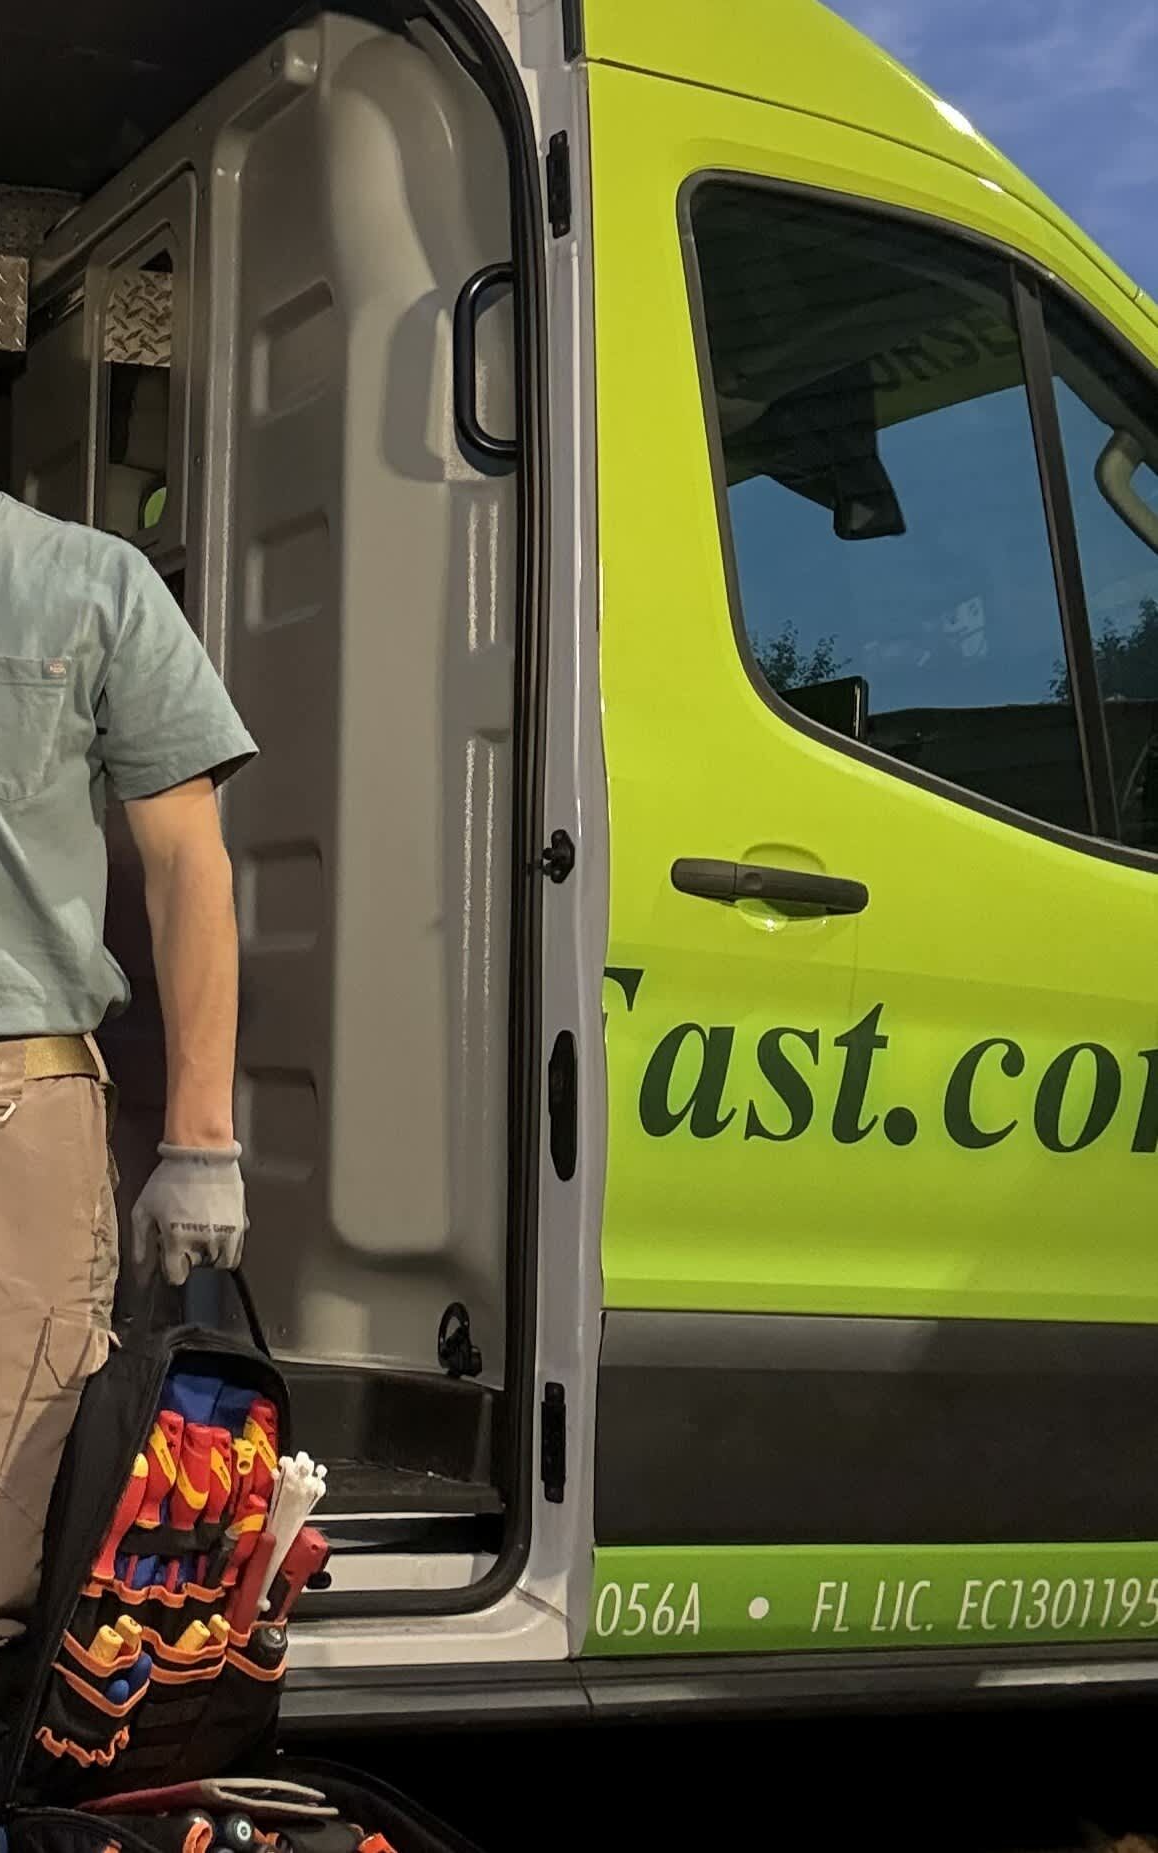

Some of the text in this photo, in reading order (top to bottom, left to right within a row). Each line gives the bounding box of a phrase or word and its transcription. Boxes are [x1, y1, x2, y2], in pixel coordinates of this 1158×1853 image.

[603, 967, 1158, 1153] ast.co
[595, 1582, 700, 1637] 056A
[811, 1581, 850, 1633] FL
[870, 1580, 935, 1632] LIC.
